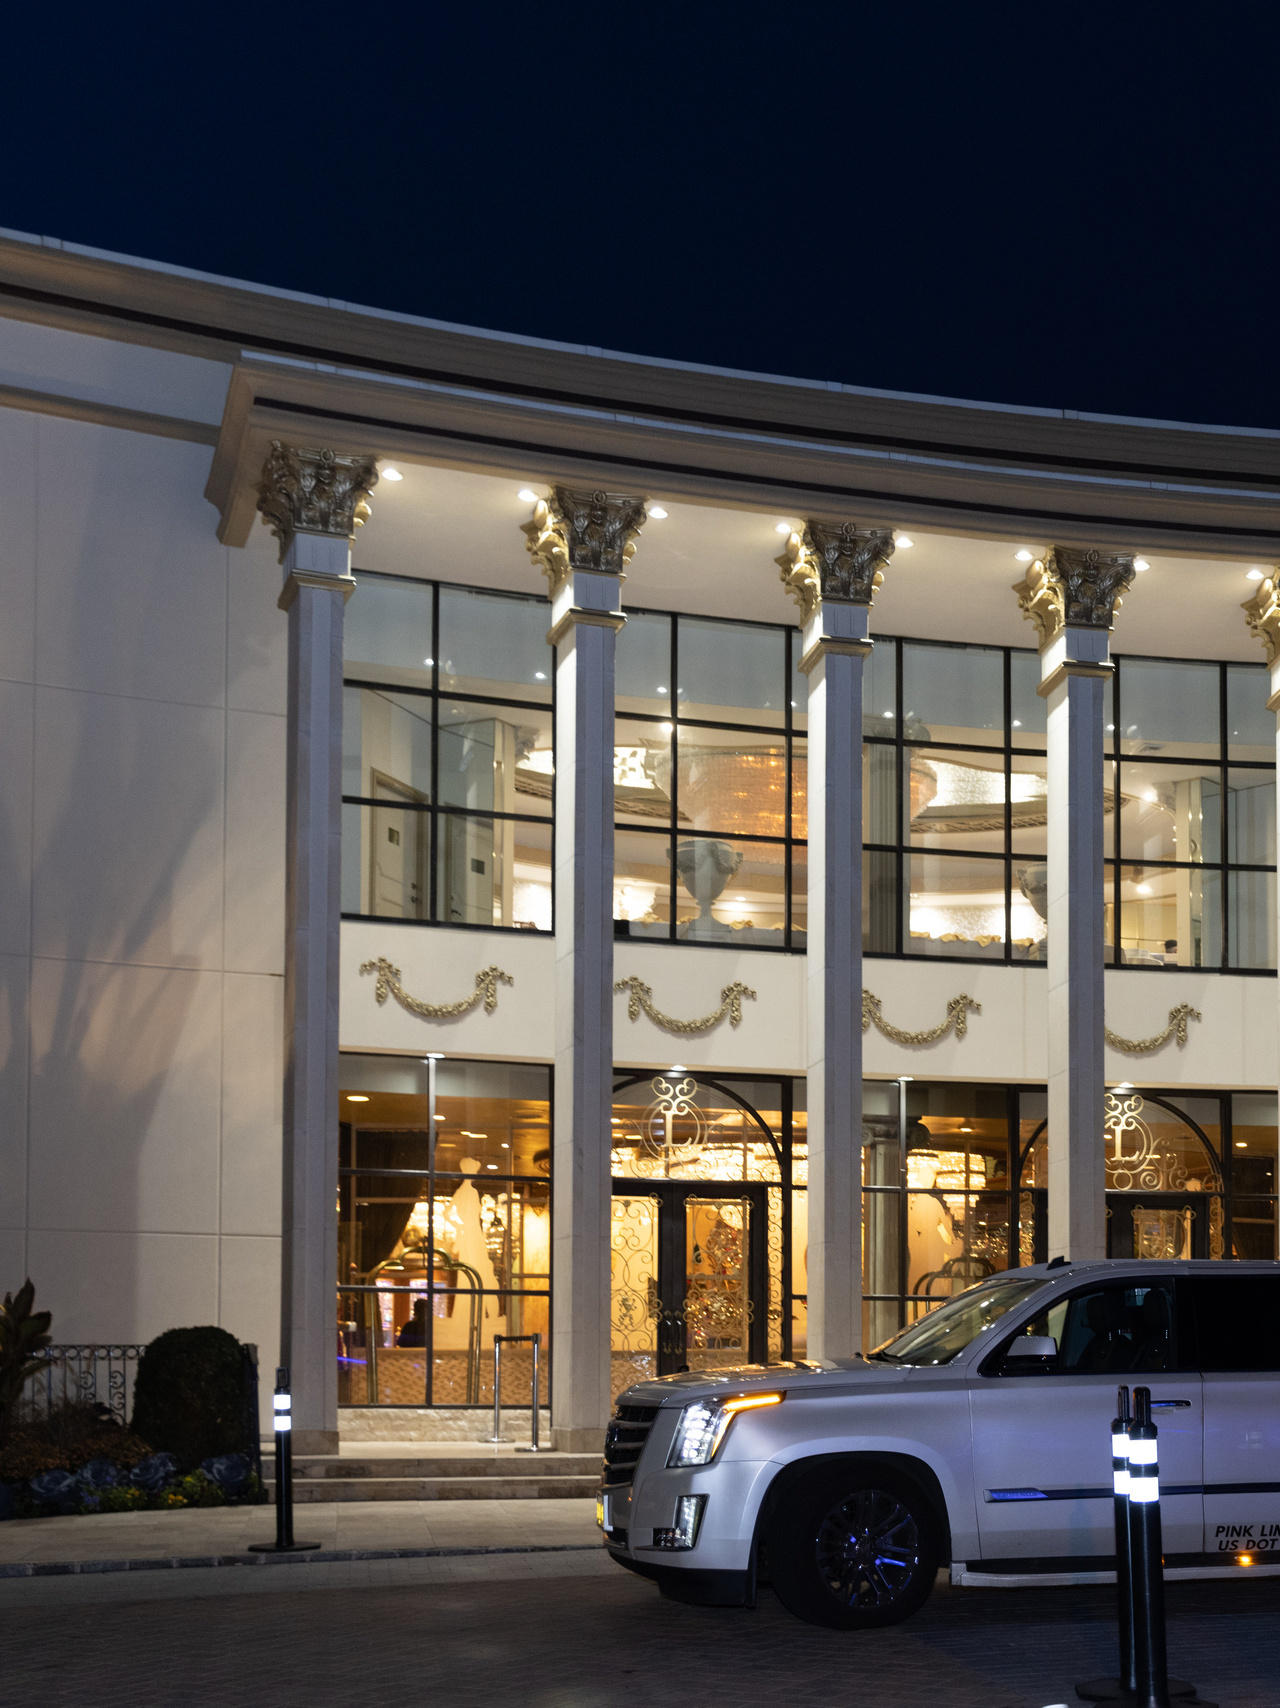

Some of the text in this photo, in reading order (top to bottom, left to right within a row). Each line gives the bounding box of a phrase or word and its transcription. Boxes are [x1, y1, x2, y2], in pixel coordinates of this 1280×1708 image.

[1215, 1525, 1254, 1538] PINK
[1218, 1540, 1239, 1551] US
[1245, 1538, 1279, 1550] DOT
